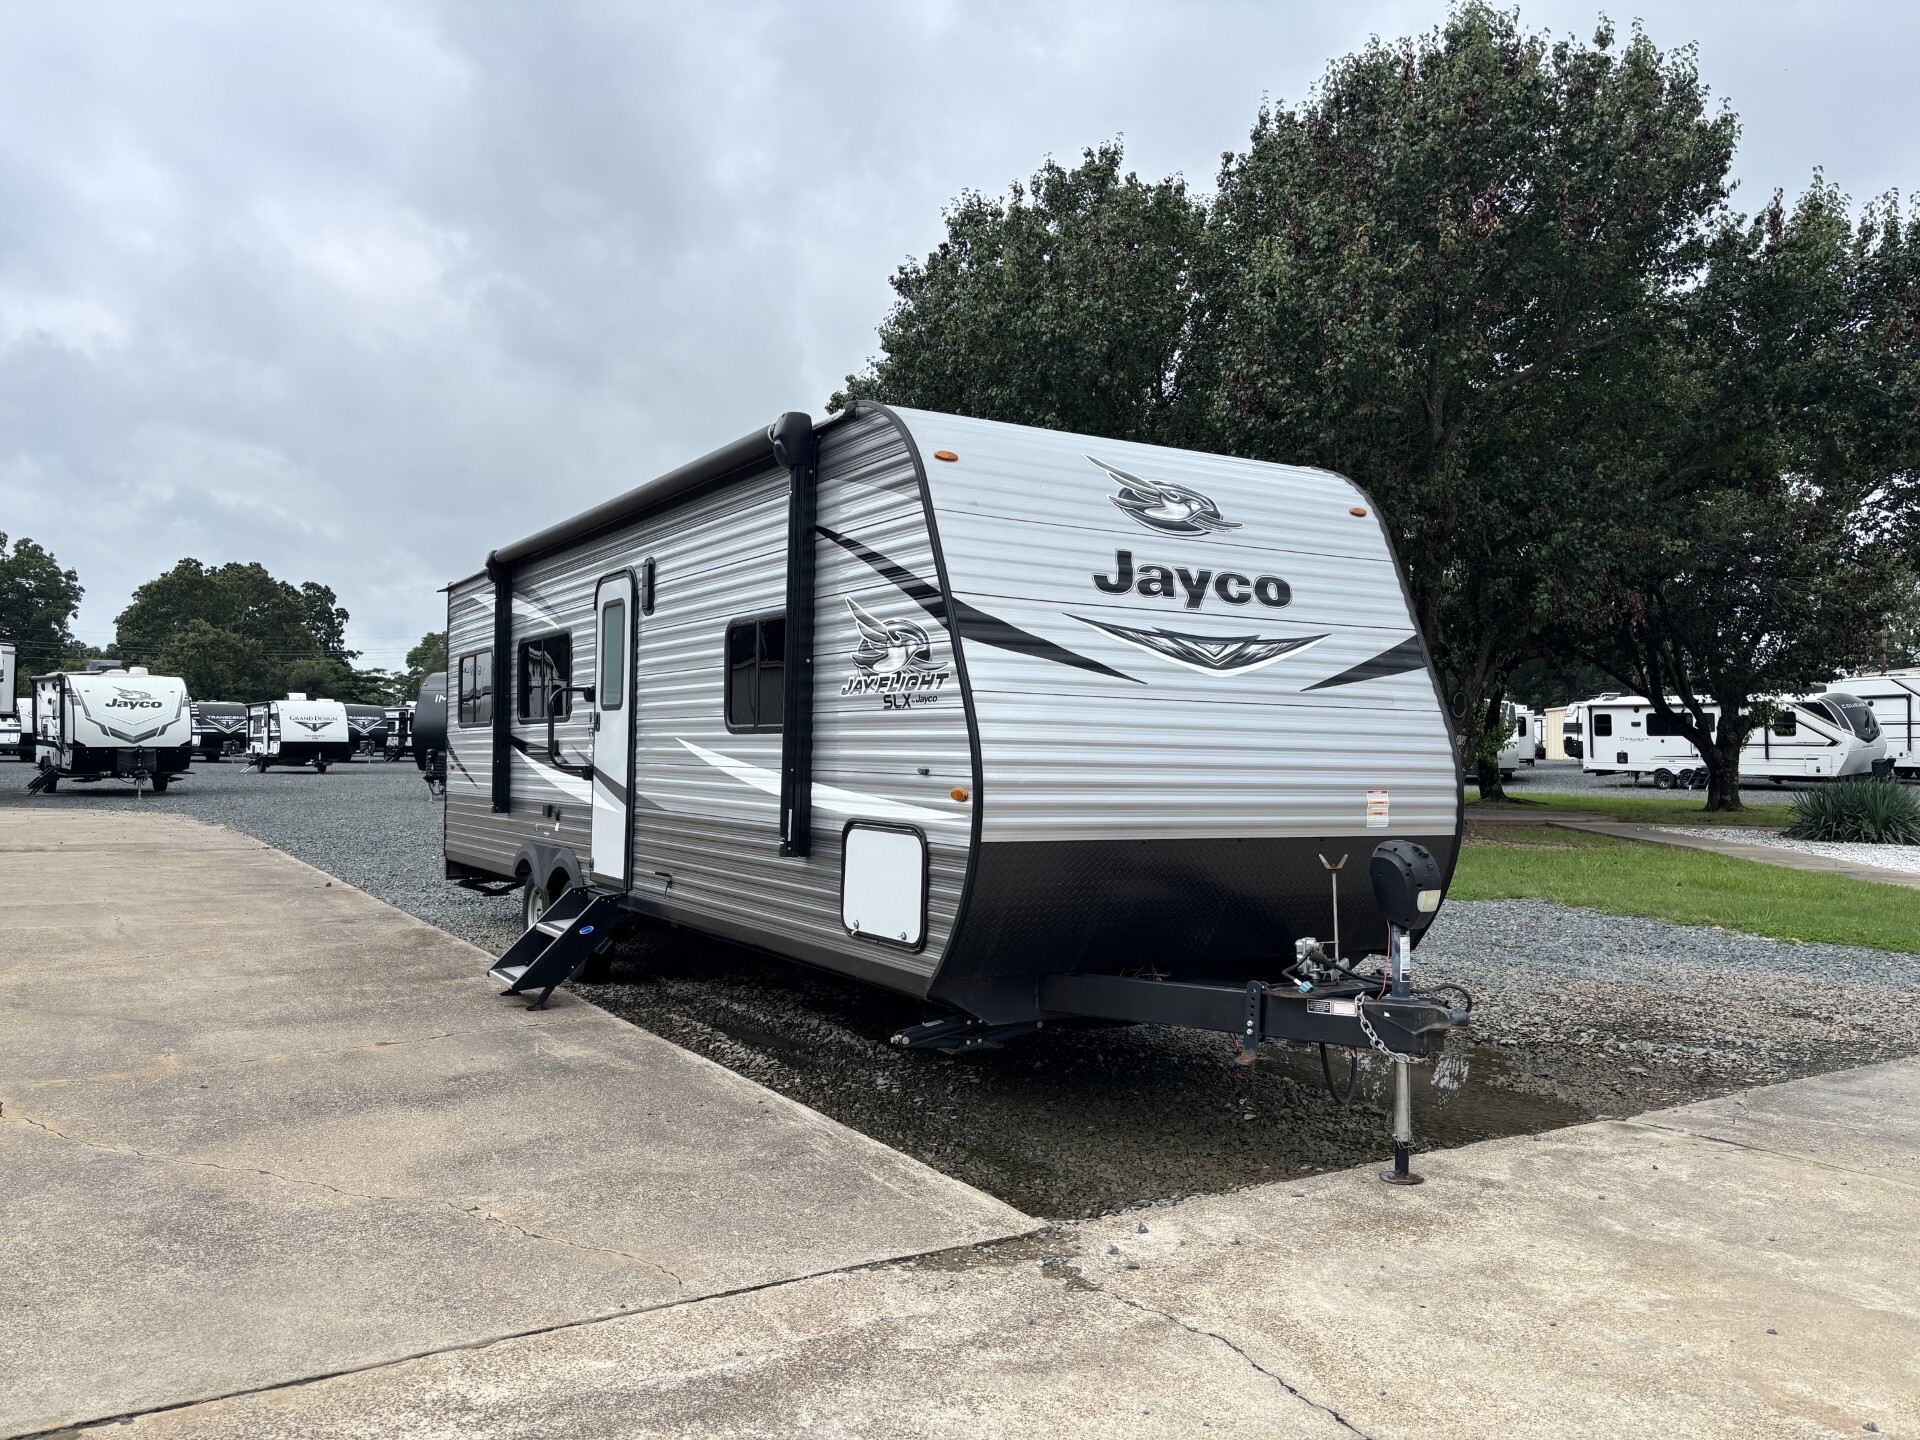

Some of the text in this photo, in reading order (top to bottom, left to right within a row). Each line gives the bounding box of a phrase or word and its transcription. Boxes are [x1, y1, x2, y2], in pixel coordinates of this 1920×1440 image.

[1091, 548, 1293, 610] Jayco
[105, 698, 162, 710] Jayco
[883, 693, 912, 709] SLX
[916, 694, 938, 705] Jayco
